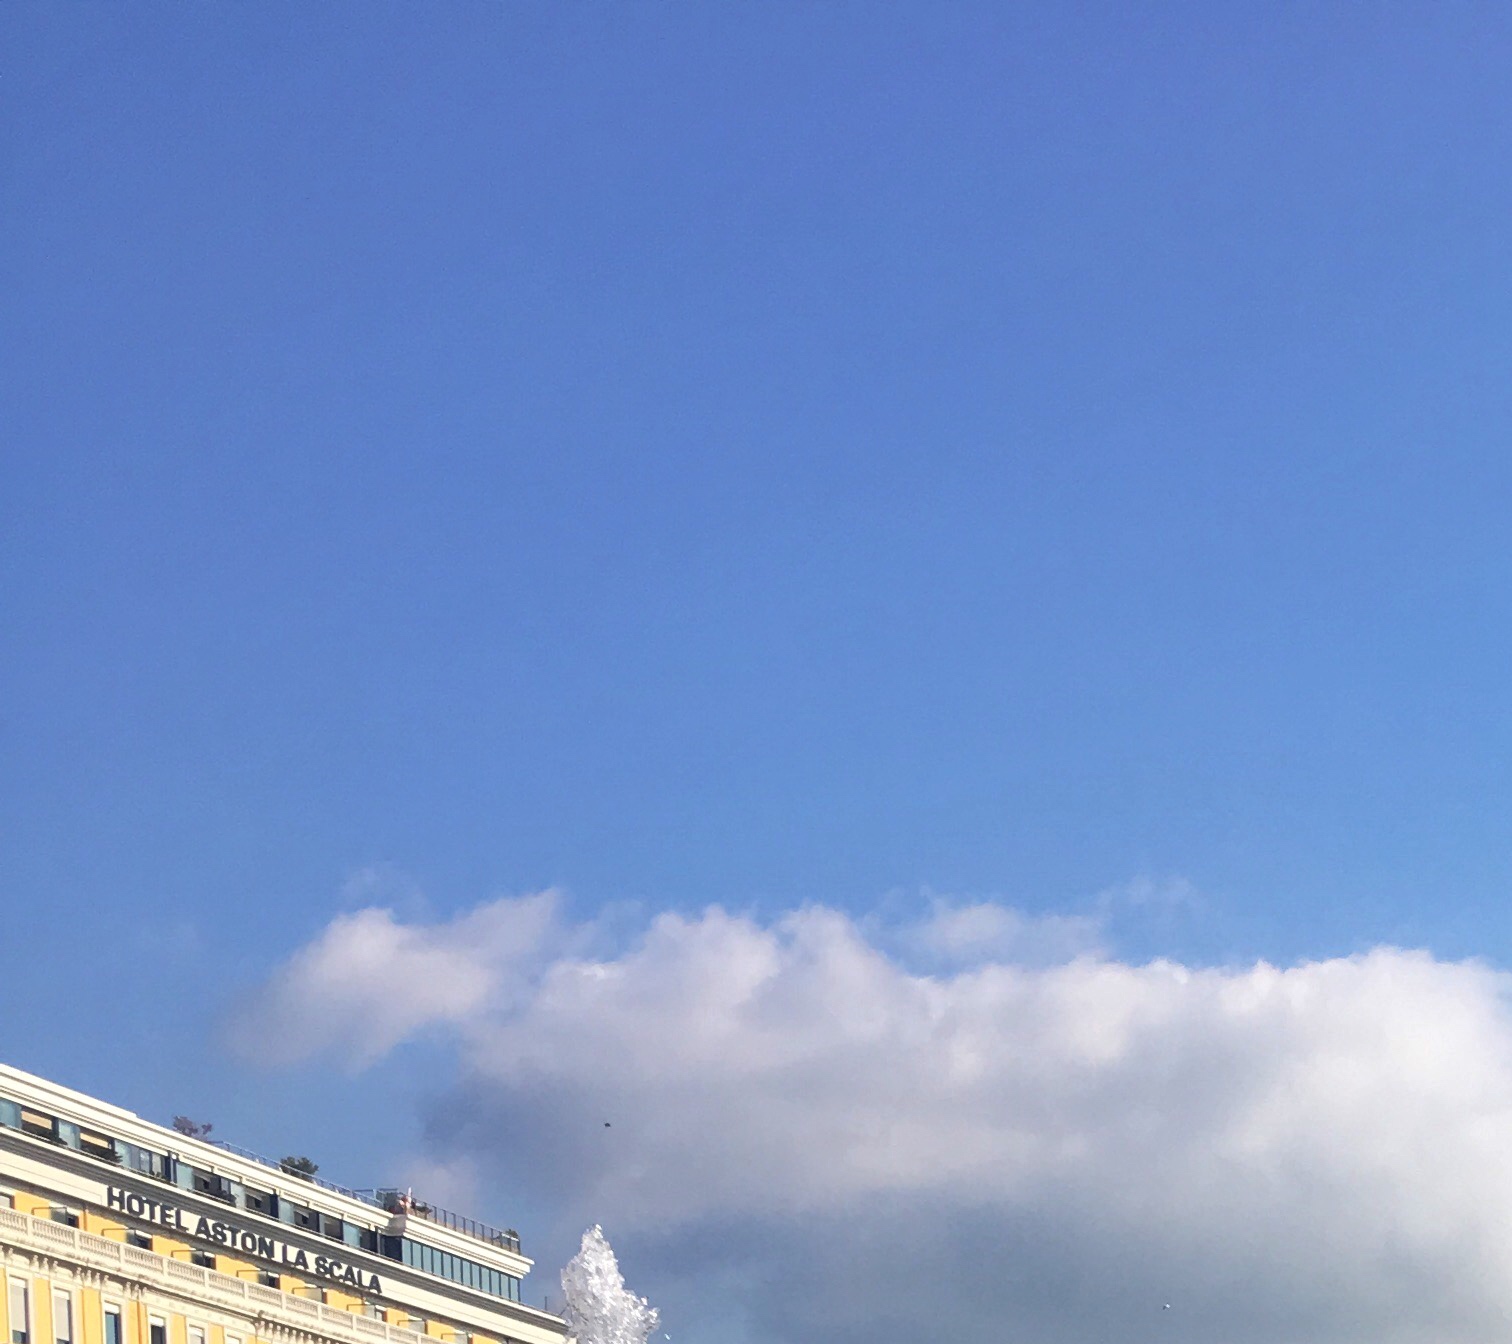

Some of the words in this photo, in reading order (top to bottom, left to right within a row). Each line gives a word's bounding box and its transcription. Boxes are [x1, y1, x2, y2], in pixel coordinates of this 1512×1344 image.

[107, 1185, 190, 1233] HOTEL
[195, 1216, 275, 1260] ASTON
[281, 1243, 309, 1270] LA
[315, 1255, 382, 1294] SCALA
